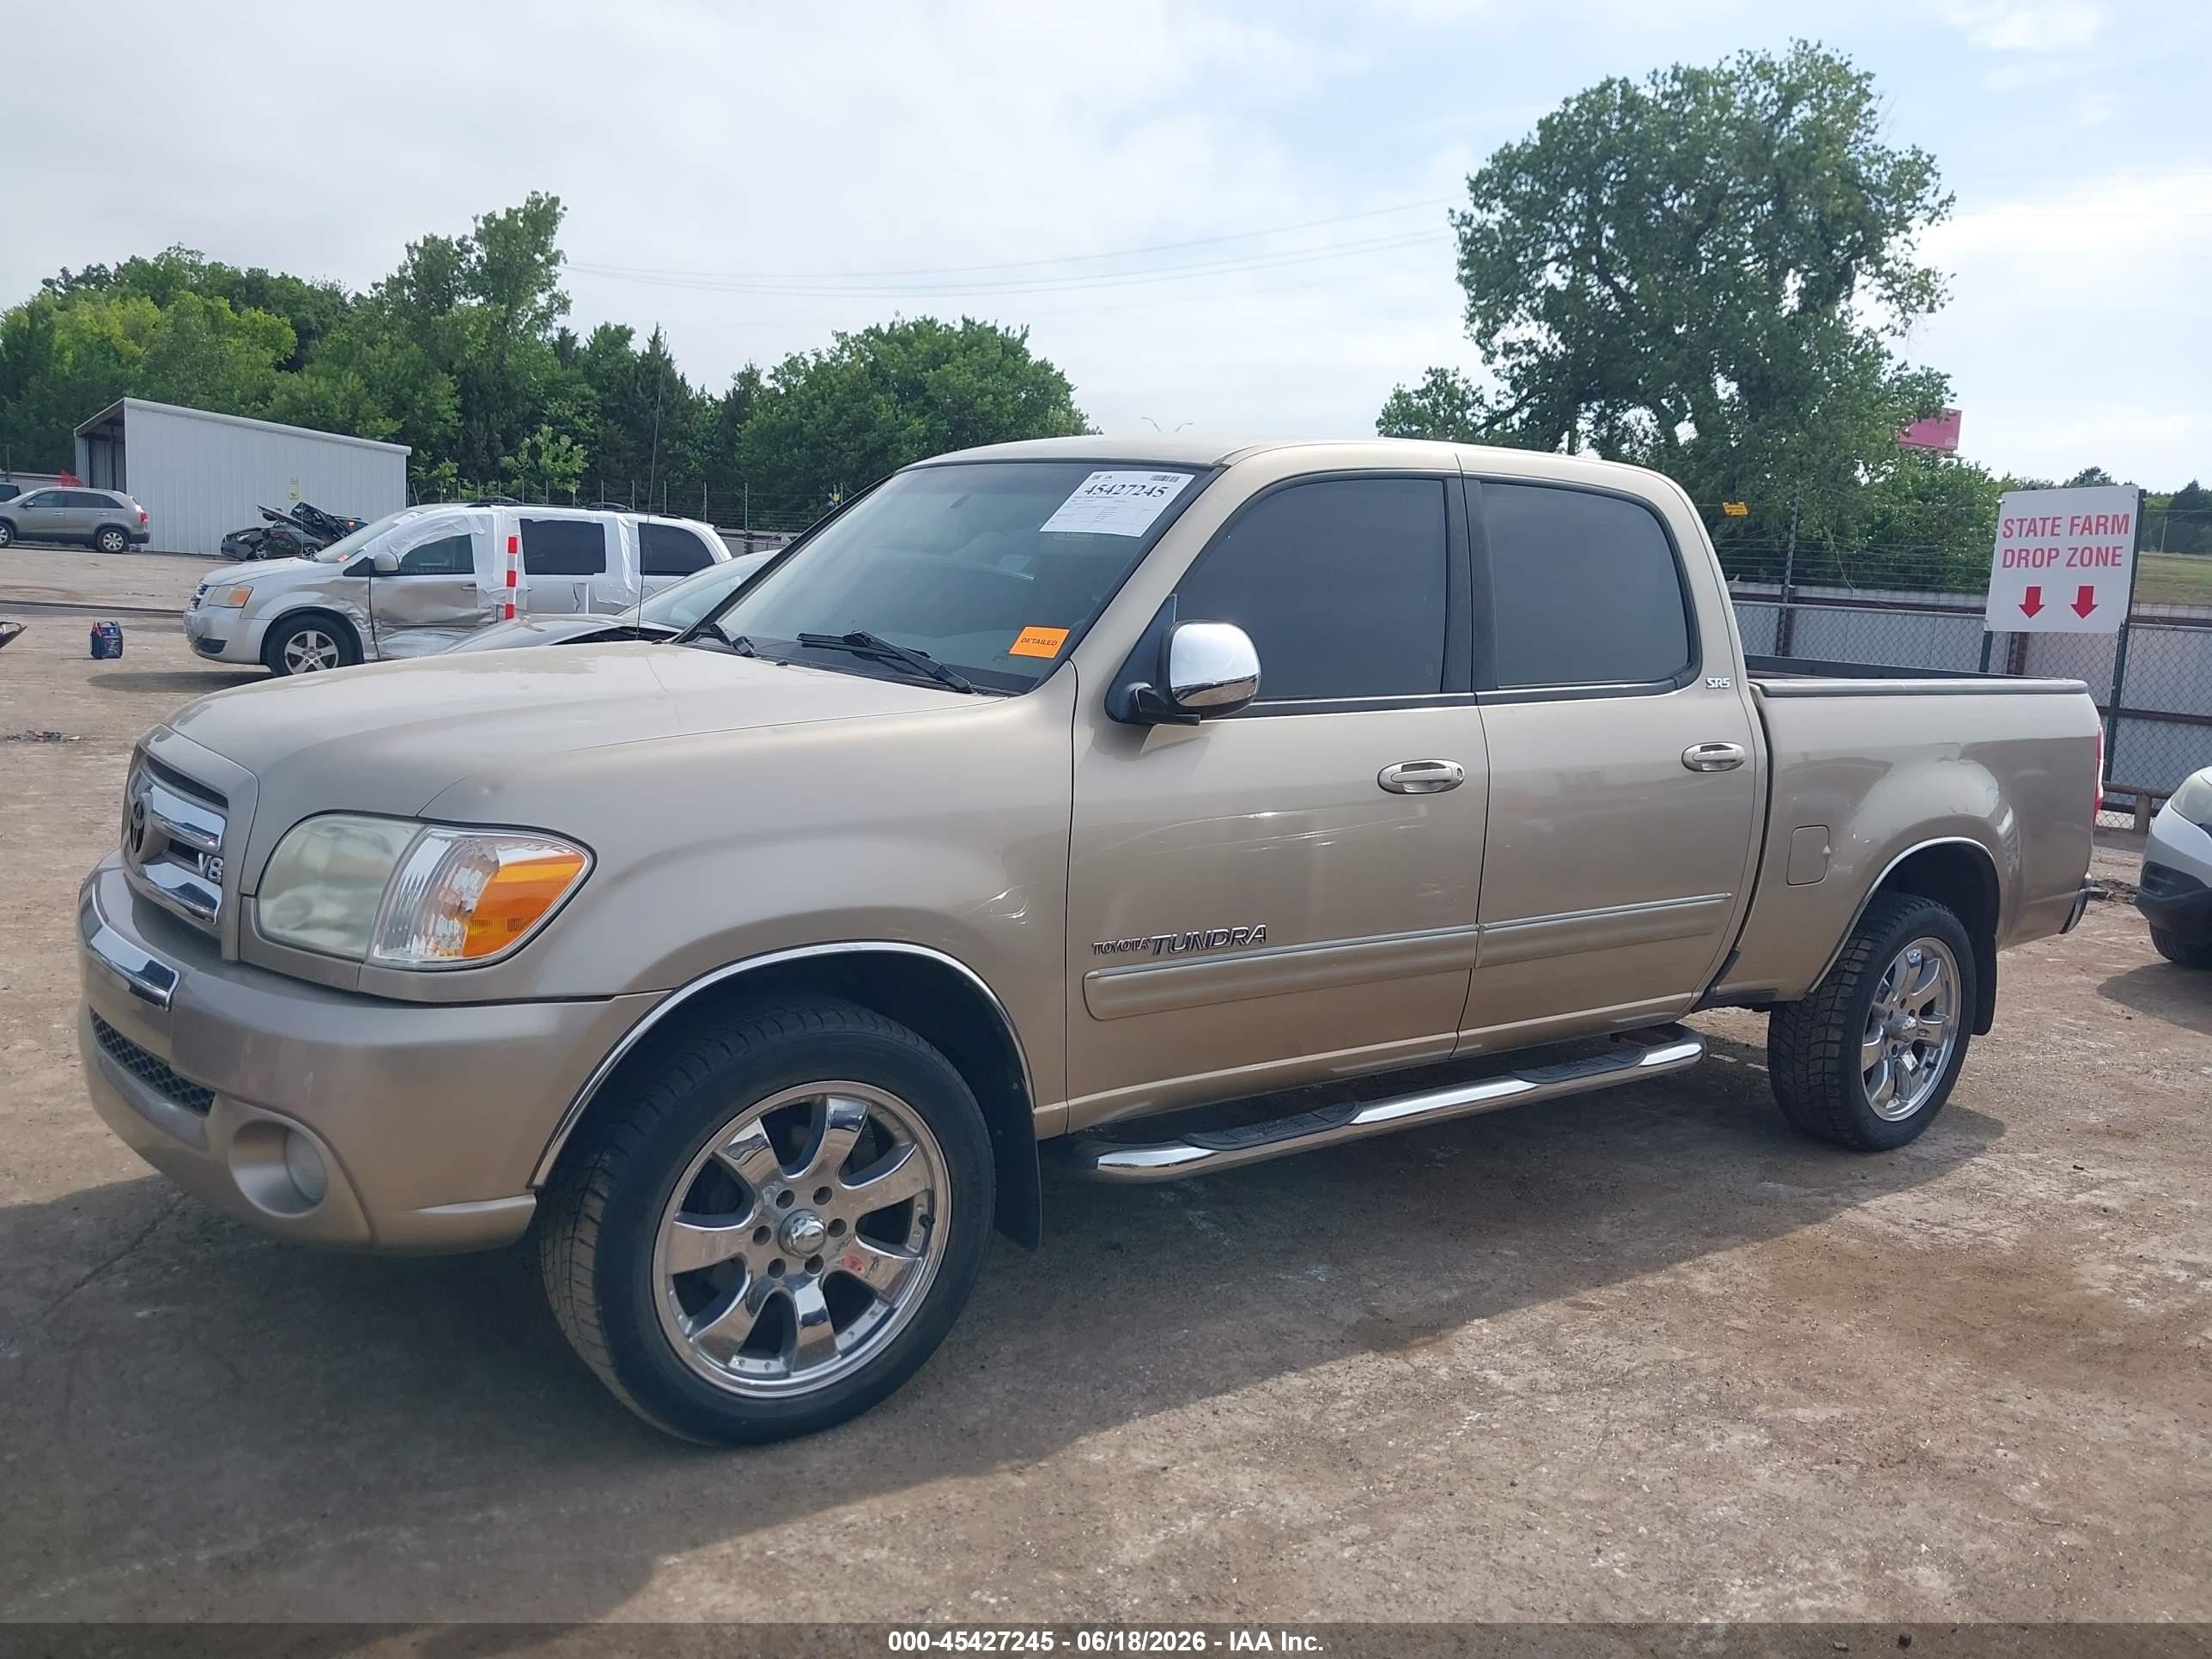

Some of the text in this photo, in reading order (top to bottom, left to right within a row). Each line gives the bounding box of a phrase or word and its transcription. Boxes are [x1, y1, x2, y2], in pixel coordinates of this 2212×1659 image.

[1085, 483, 1168, 498] 45427245
[2002, 514, 2130, 539] STATE FARM
[2002, 545, 2124, 568] DROP ZONE
[1020, 637, 1058, 647] DETAILED
[1705, 677, 1731, 689] SR5
[198, 852, 223, 884] V8
[1092, 924, 1267, 956] TOYOTA TUNDRA
